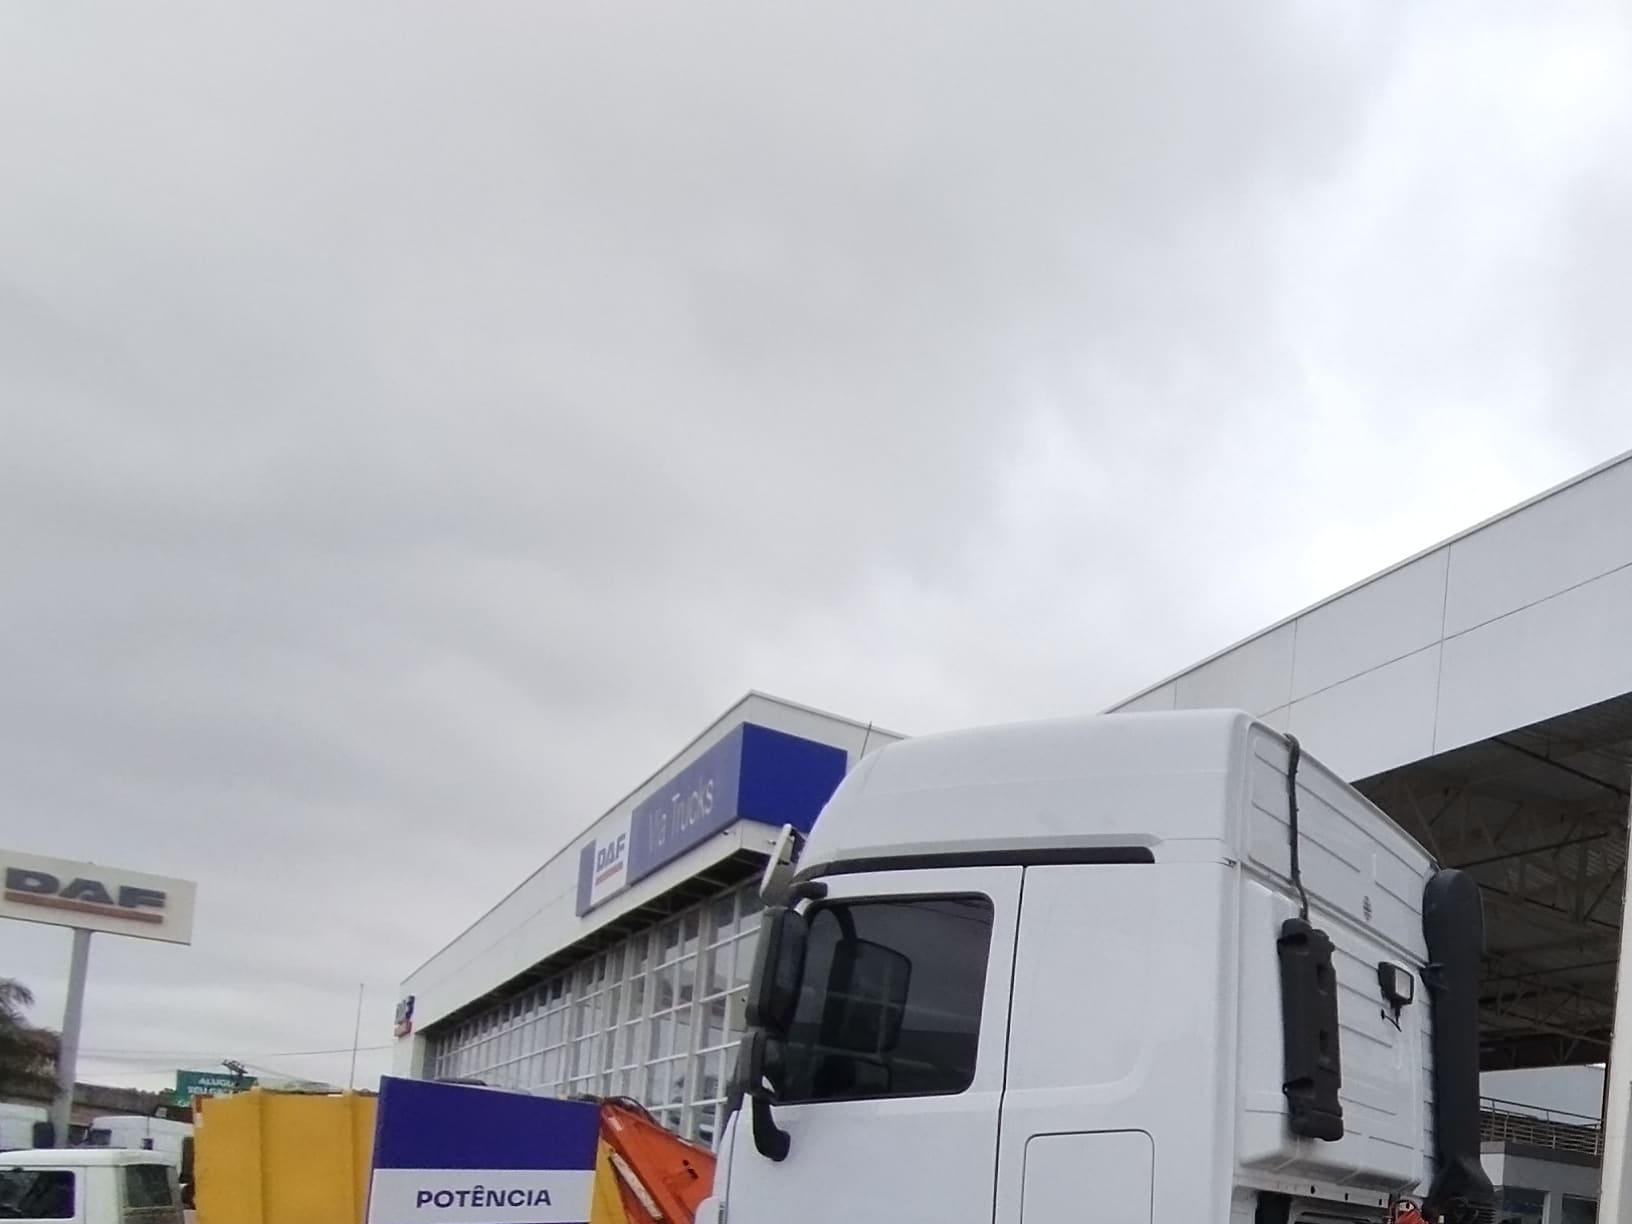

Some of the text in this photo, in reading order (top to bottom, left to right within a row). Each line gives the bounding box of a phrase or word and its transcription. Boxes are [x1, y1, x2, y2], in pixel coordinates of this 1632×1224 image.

[597, 833, 626, 873] DAF
[6, 867, 166, 909] DAF
[416, 1185, 552, 1208] POTÊNCIA
